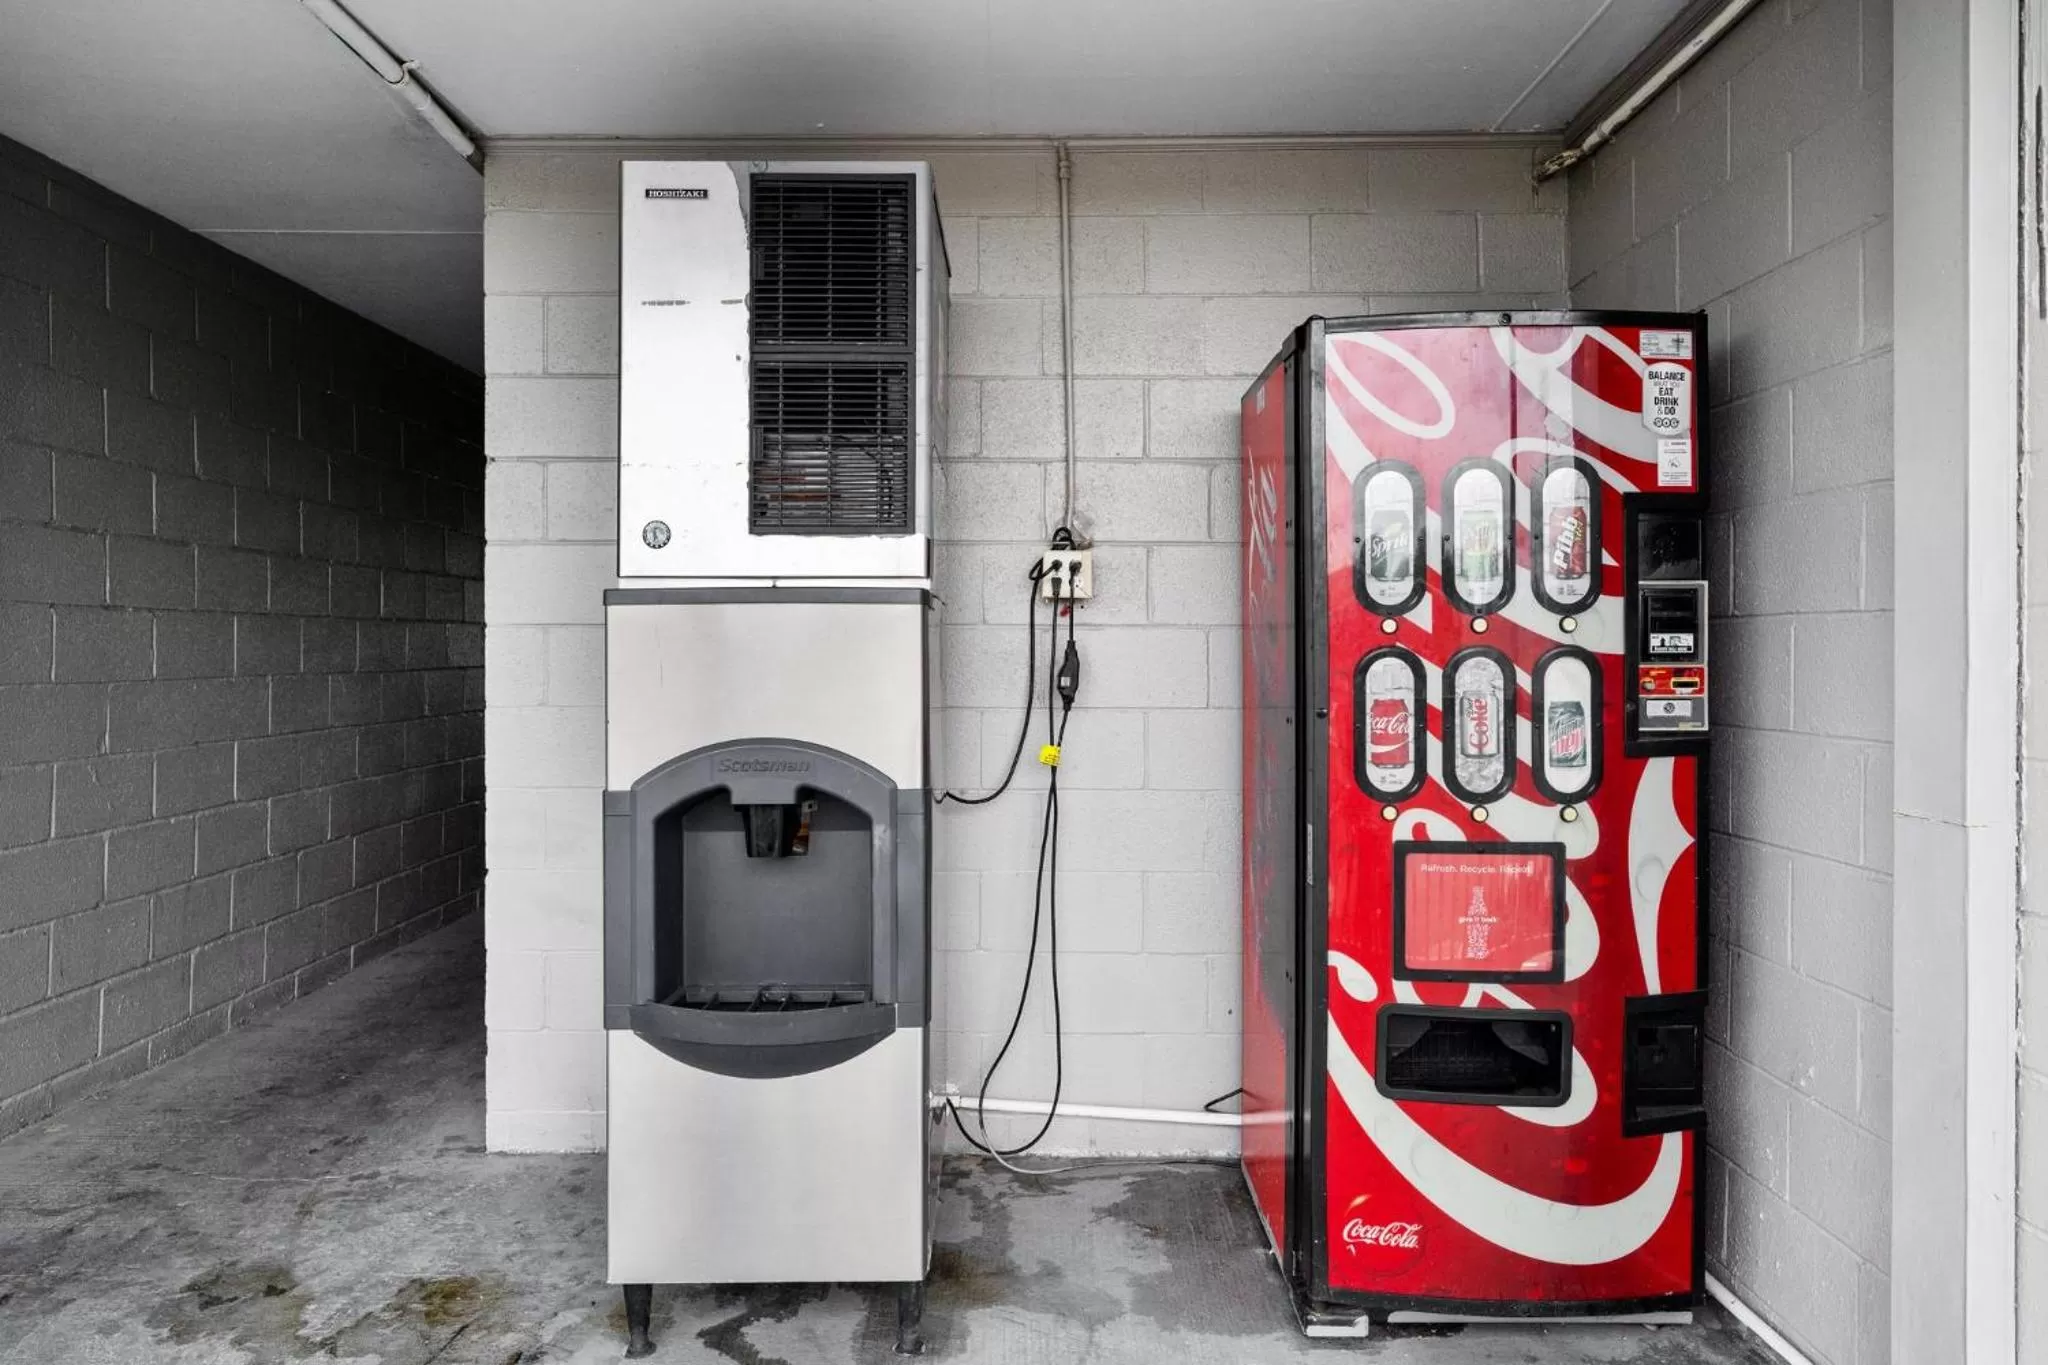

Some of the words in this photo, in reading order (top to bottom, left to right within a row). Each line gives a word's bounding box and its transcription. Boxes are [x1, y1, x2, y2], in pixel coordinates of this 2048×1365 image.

[1648, 371, 1685, 381] BALANCE
[1658, 387, 1674, 396] EAT
[1654, 397, 1679, 406] DRINK
[1664, 407, 1676, 415] DO
[1469, 698, 1489, 752] Coke
[1343, 1218, 1423, 1249] Coca-Cola
